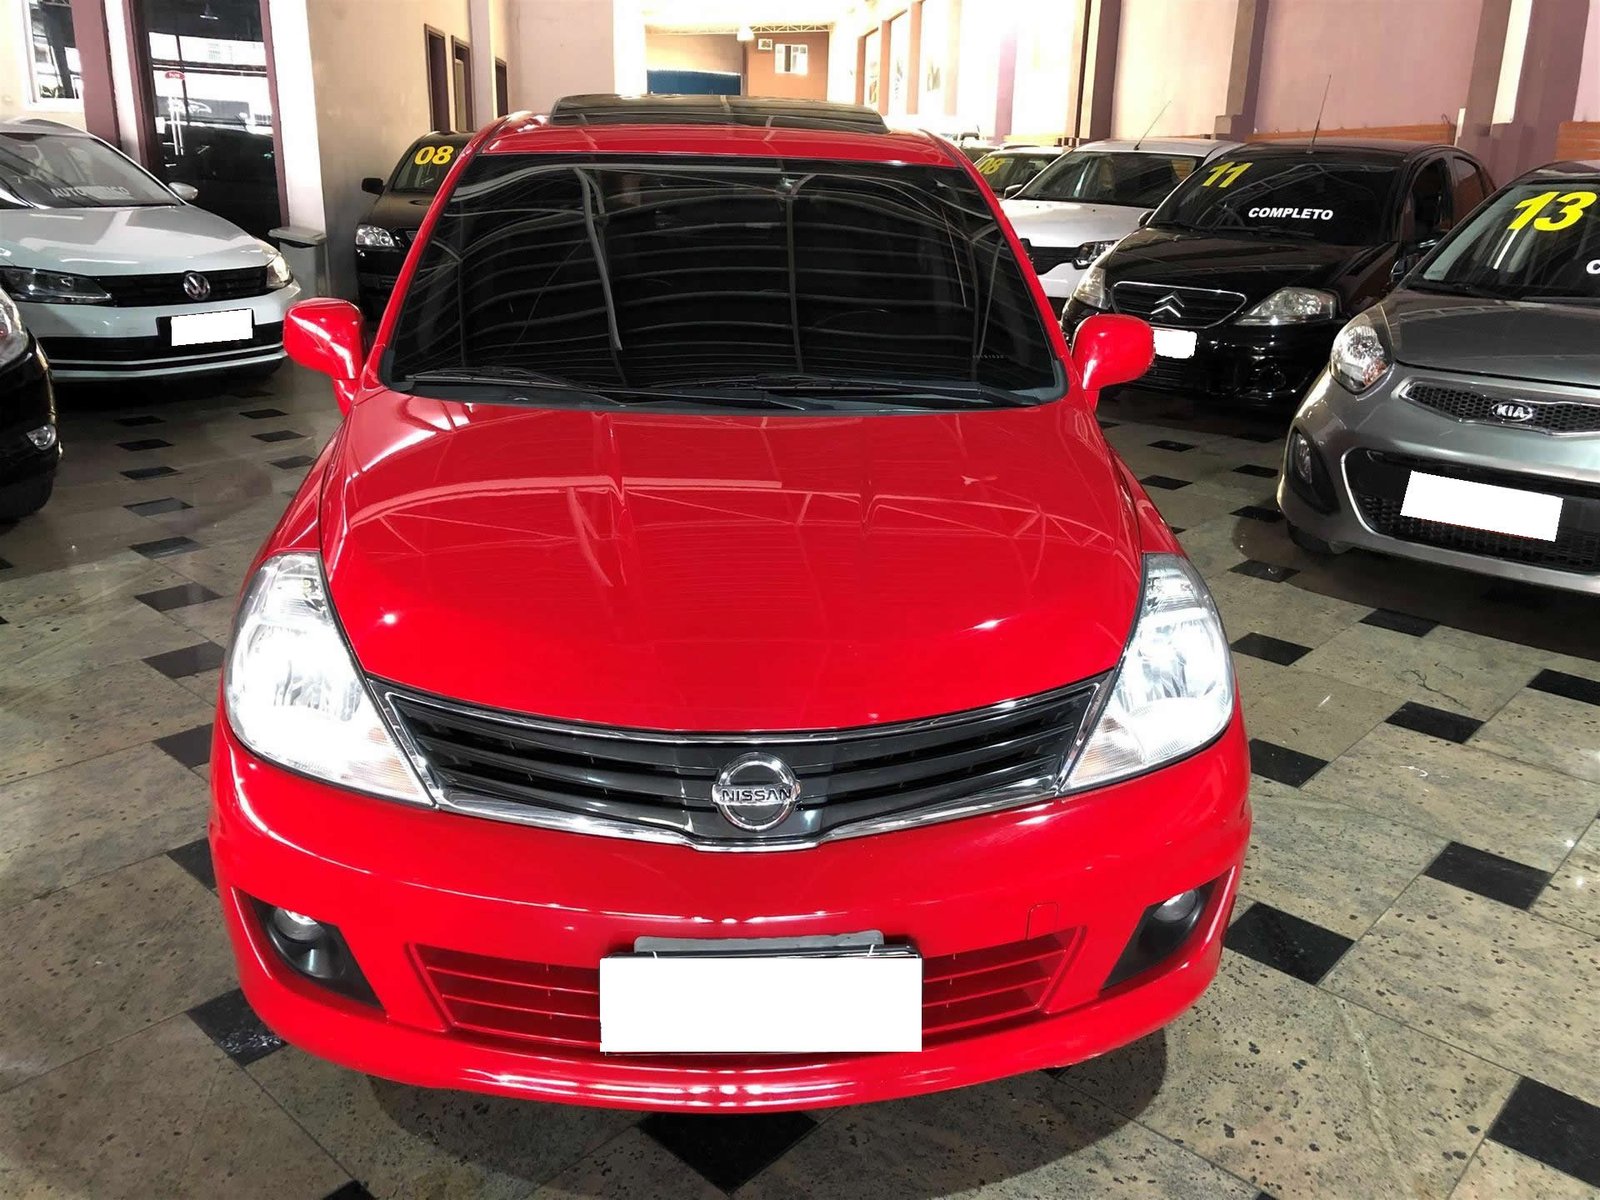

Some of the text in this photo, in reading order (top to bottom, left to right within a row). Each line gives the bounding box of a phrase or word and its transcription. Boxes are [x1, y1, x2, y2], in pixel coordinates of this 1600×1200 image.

[414, 145, 454, 165] 08
[1201, 161, 1254, 188] 11
[1248, 207, 1334, 221] COMPLETO
[1507, 191, 1598, 231] 13
[1497, 404, 1527, 418] KIA
[722, 788, 792, 802] NISSAN
